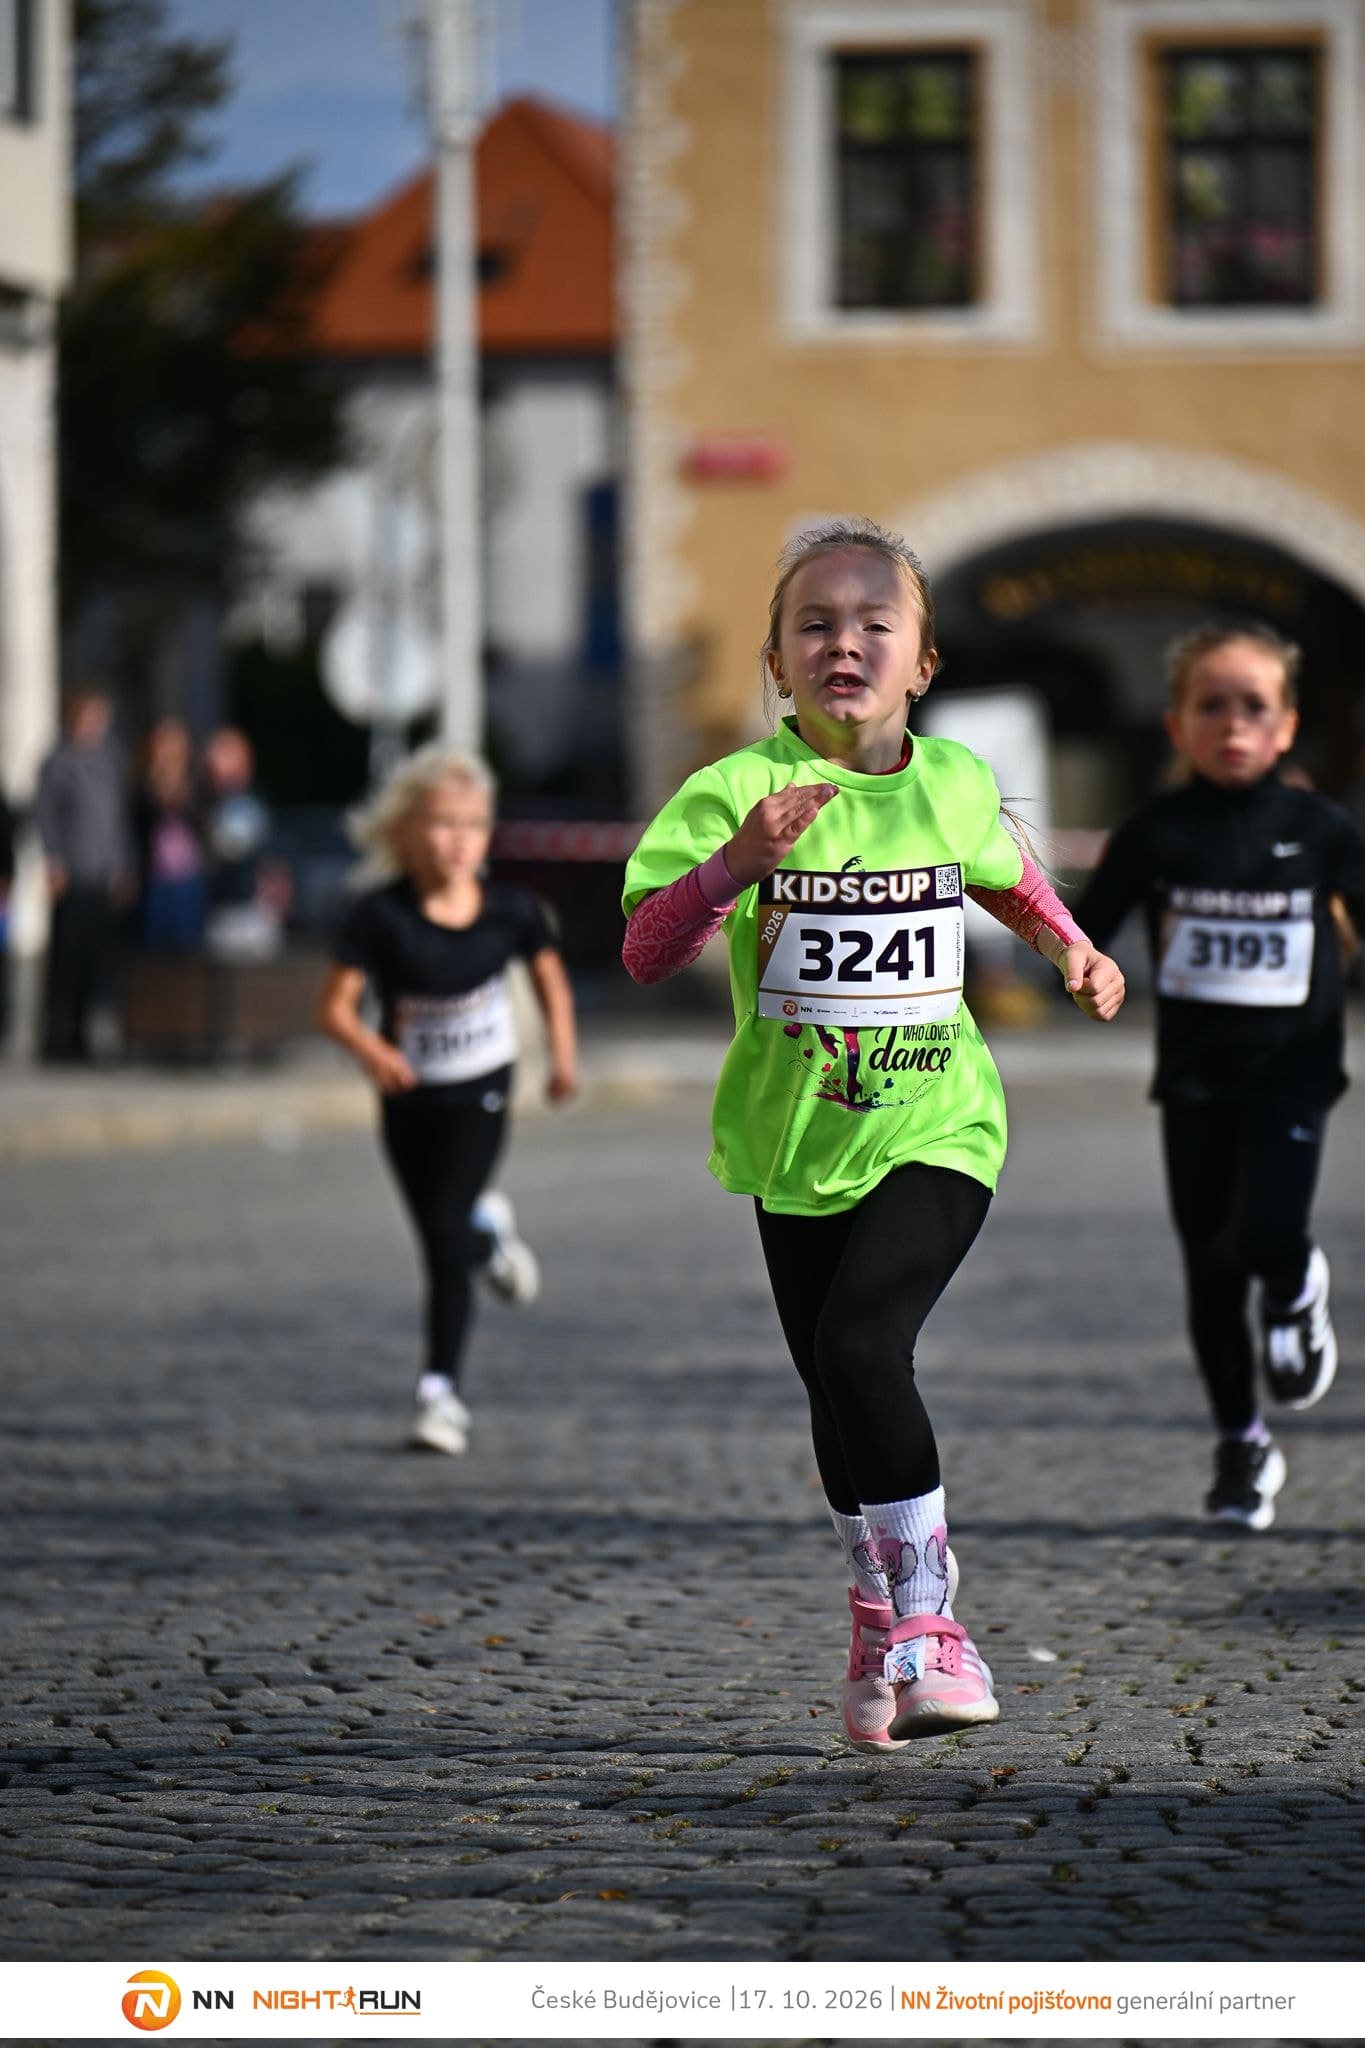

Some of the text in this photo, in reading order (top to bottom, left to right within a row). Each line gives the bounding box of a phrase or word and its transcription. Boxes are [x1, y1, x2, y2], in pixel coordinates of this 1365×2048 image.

[773, 872, 929, 903] KIDSCUP
[761, 910, 783, 945] 2026
[799, 926, 934, 982] 3241
[1188, 928, 1287, 970] 3193
[869, 1026, 952, 1073] dance
[903, 1025, 925, 1041] WHO
[925, 1024, 949, 1041] LOVES
